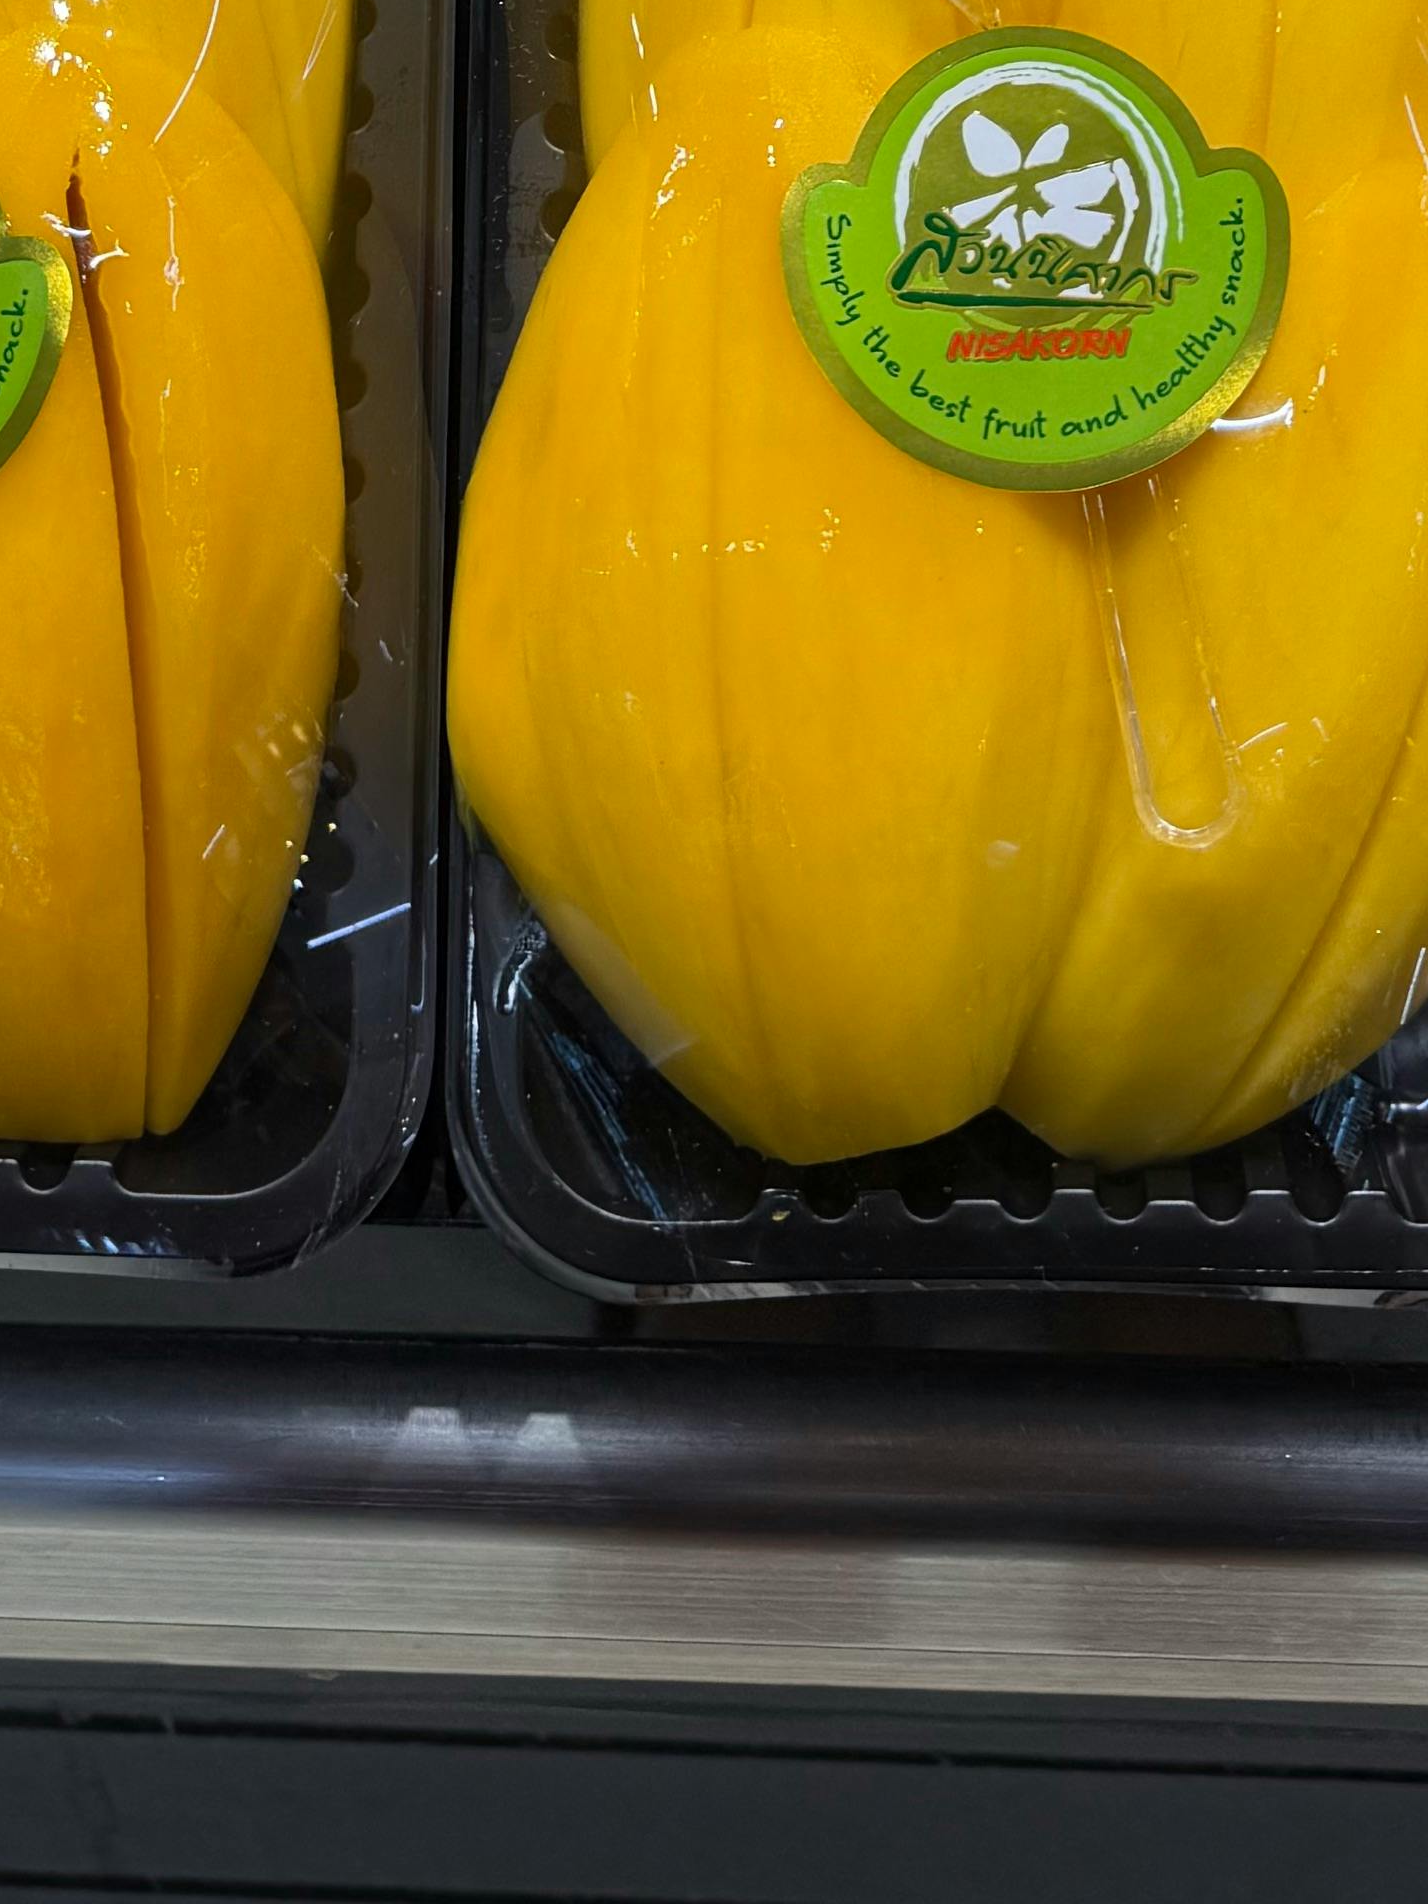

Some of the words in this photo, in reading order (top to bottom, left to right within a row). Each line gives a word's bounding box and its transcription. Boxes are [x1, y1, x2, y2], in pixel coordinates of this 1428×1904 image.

[821, 214, 861, 326] Simply
[864, 326, 901, 377] the
[910, 375, 971, 423] best
[983, 411, 1046, 439] fruit
[1061, 398, 1129, 436] and
[1131, 317, 1235, 411] healthy
[1219, 196, 1245, 305] snack.
[947, 328, 1131, 361] NISAKORN
